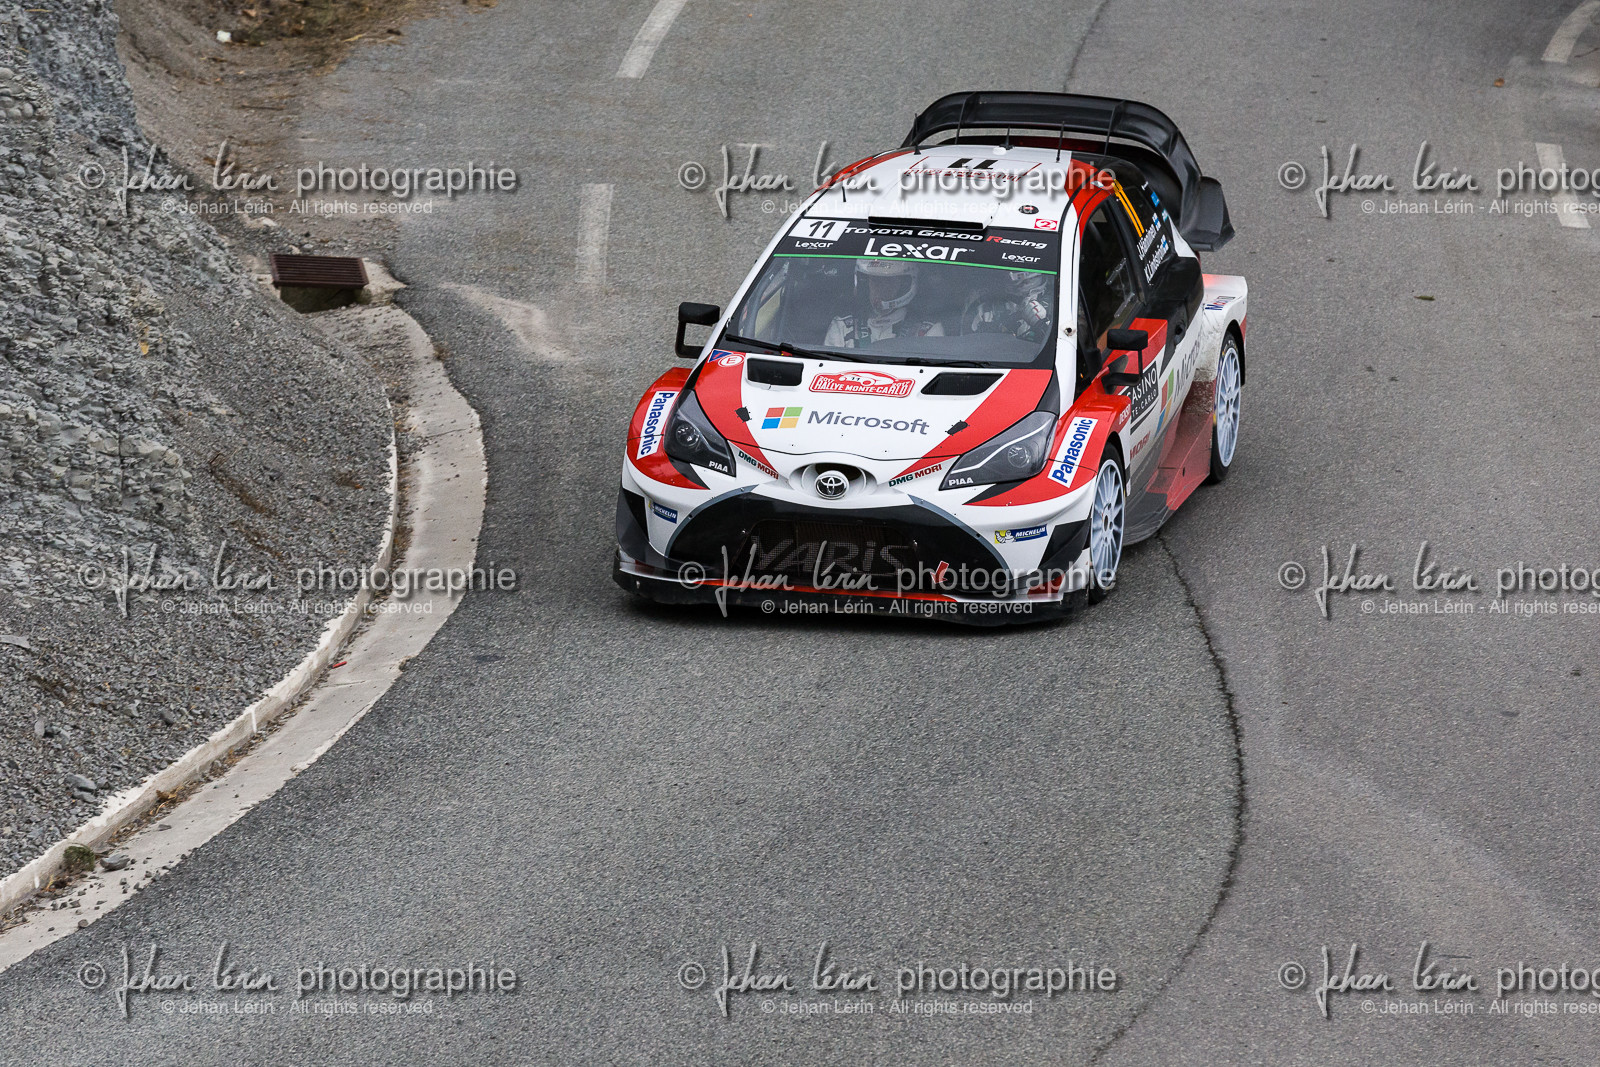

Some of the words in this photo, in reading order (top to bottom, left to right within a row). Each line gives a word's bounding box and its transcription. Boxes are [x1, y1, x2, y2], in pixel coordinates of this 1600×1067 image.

[808, 220, 837, 239] 11
[844, 227, 913, 235] TOYOTA
[917, 229, 983, 240] GAZOO
[986, 235, 1047, 249] Racing
[795, 240, 834, 248] Lexar
[1001, 252, 1041, 263] Lexar
[814, 379, 844, 391] RALLYE
[845, 383, 909, 396] MONTE-CARLO
[640, 392, 676, 456] Panasonic
[807, 410, 930, 435] Microsoft
[1051, 419, 1093, 484] Panasonic
[709, 461, 729, 472] PIAA
[738, 450, 757, 467] DMG
[757, 462, 779, 480] MORI
[888, 474, 914, 487] DMG
[914, 463, 943, 479] MORI
[948, 477, 974, 486] PIAA
[1015, 526, 1046, 537] MICHELIN
